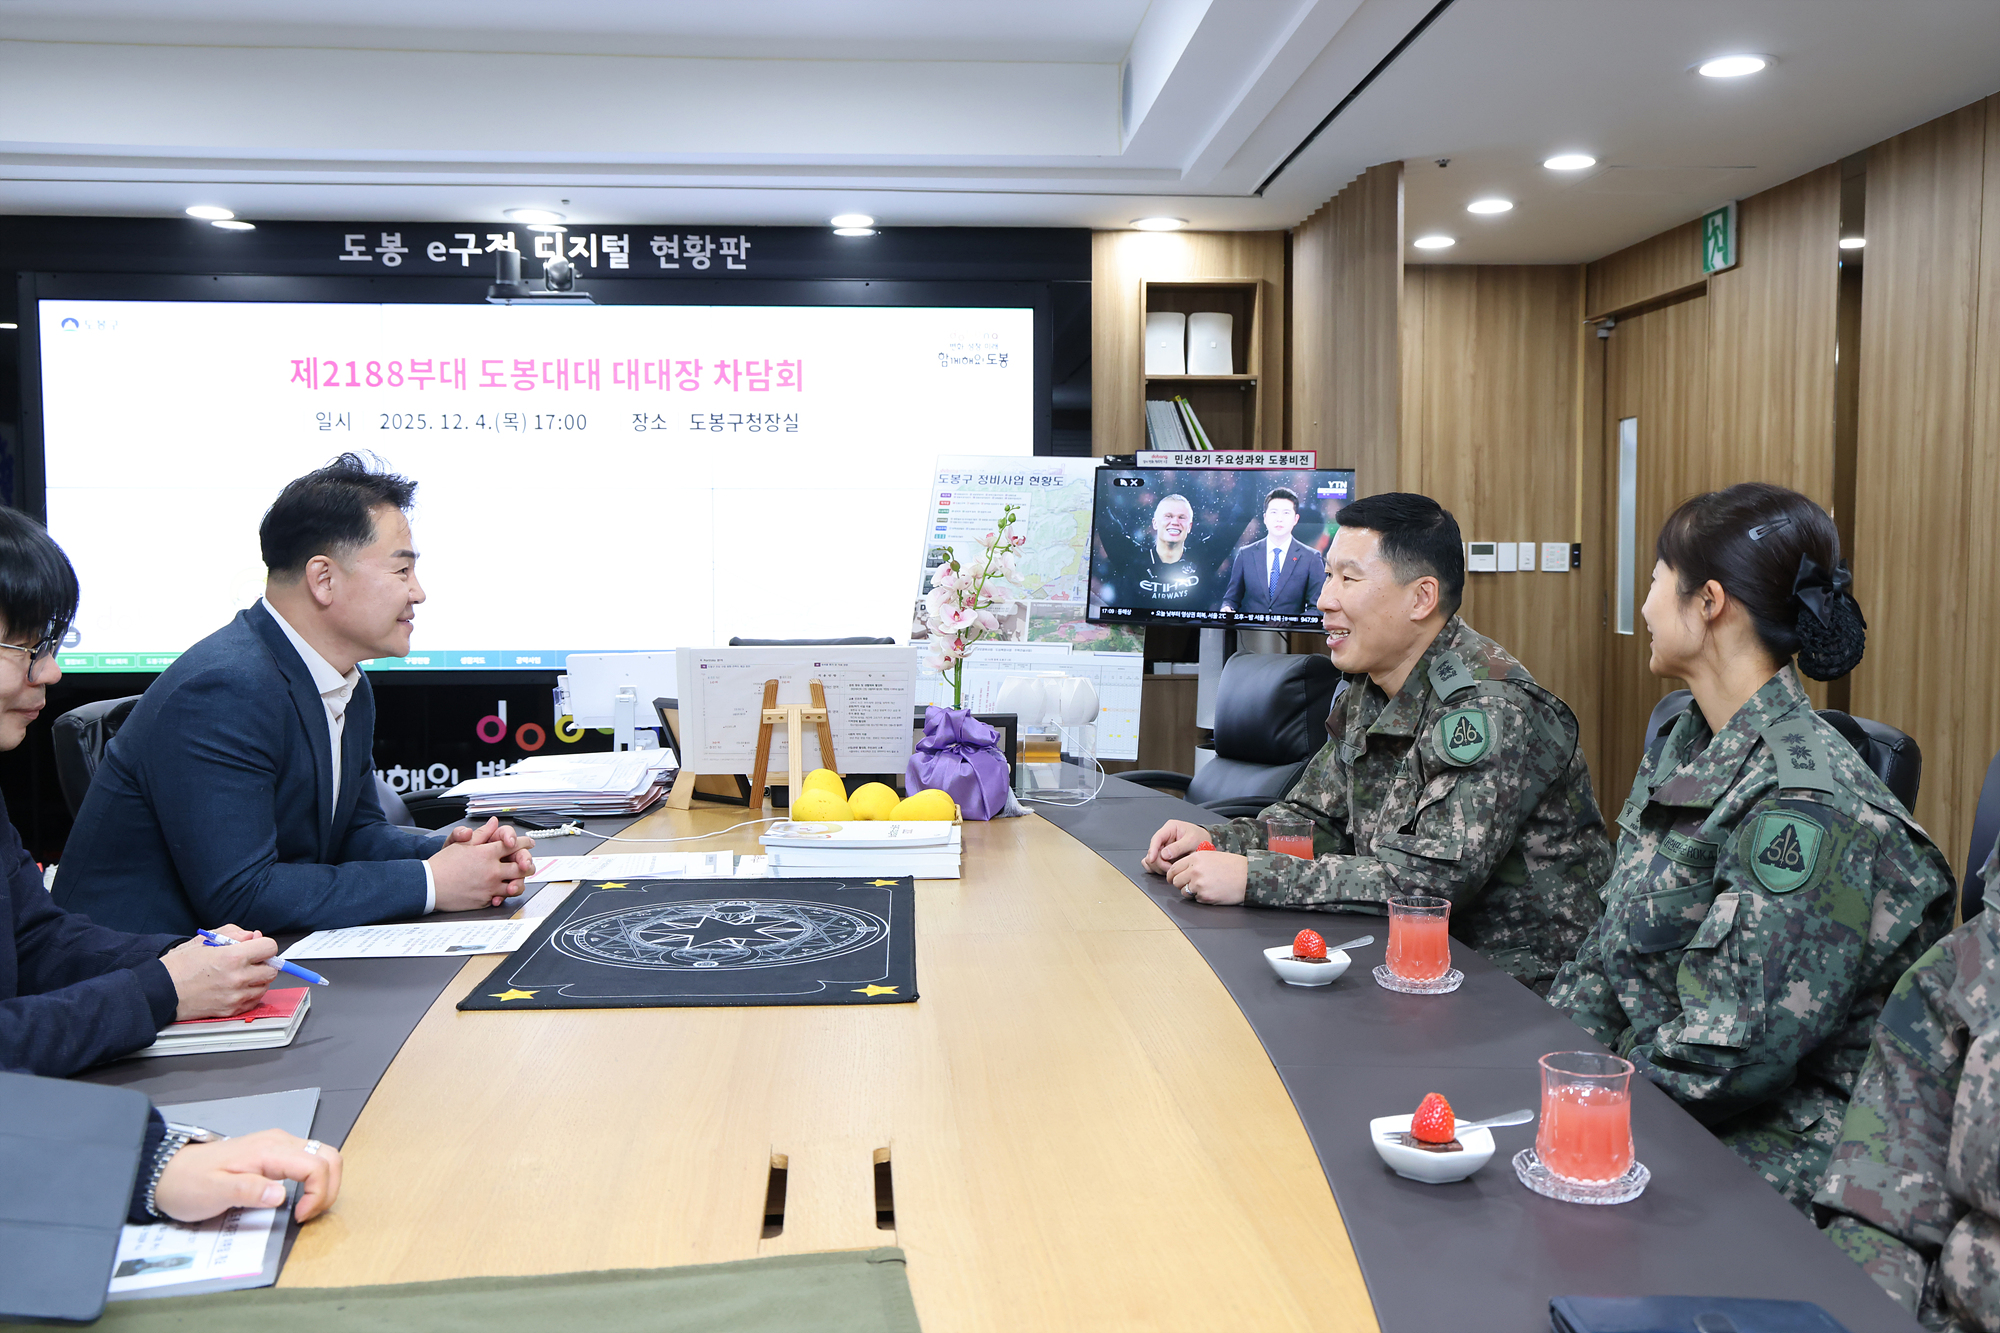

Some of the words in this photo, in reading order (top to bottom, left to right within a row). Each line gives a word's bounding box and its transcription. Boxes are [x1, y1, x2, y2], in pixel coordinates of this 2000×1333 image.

[338, 232, 409, 267] 도봉
[534, 232, 630, 269] 디지털
[650, 234, 752, 270] 현황판
[986, 352, 1009, 369] 도봉
[290, 356, 467, 391] 제2188부대
[478, 358, 601, 391] 도봉대대
[612, 358, 704, 392] 대대장
[713, 358, 804, 393] 차담회
[315, 411, 352, 431] 일시
[379, 412, 434, 431] 2025.
[440, 413, 469, 431] 12.
[475, 412, 528, 433] 4.(목)
[534, 413, 588, 431] 17:00
[632, 412, 668, 432] 장소
[689, 412, 799, 433] 도봉구청장실
[1174, 454, 1212, 465] 민선8기
[1215, 454, 1265, 466] 주요성과와
[1268, 454, 1310, 467] 도봉비전
[938, 473, 973, 485] 도봉구
[977, 474, 1025, 486] 정비사업
[1029, 476, 1065, 487] 현황도
[1328, 481, 1347, 489] YTN
[1151, 589, 1189, 599] AIRWAYS
[1453, 725, 1477, 746] 56
[1768, 837, 1800, 867] 56
